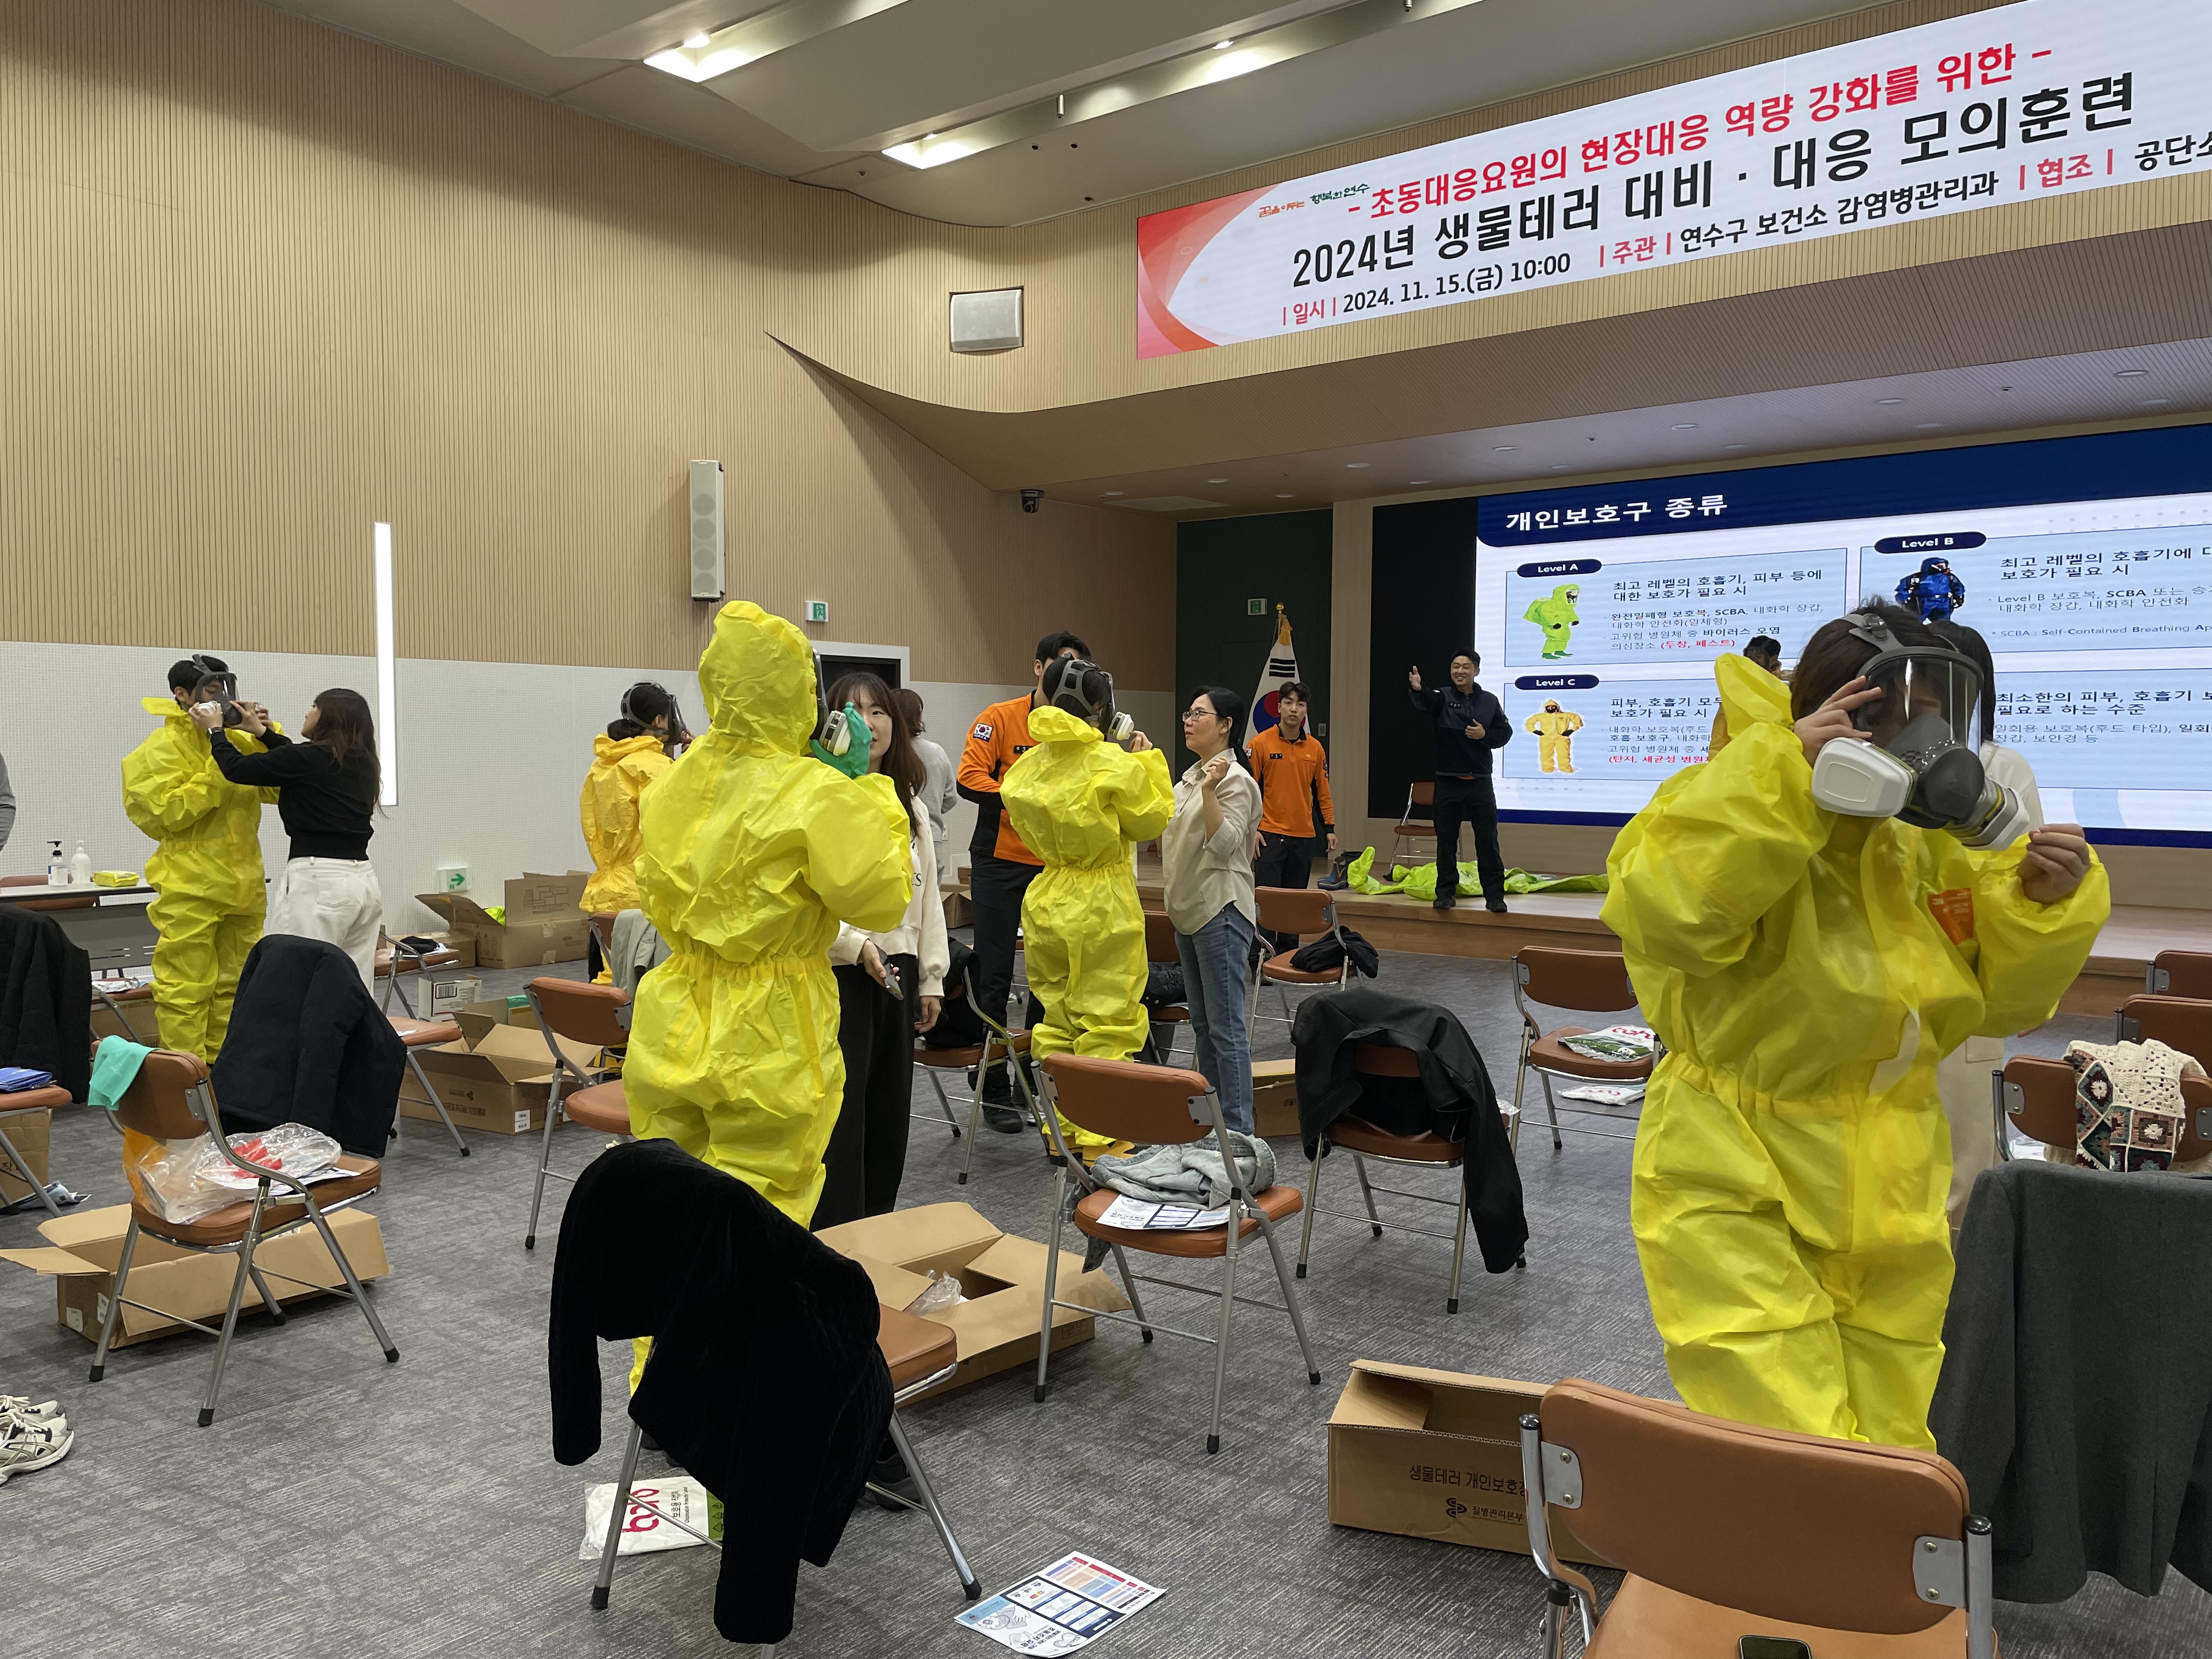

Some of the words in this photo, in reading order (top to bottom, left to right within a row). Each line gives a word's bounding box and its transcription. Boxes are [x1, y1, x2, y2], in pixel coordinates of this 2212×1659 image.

[1369, 145, 1568, 219] 초동대응요원의
[1581, 113, 1710, 172] 현장대응
[1725, 94, 1794, 138] 역량
[1809, 64, 1920, 122] 강화를
[1937, 43, 2017, 92] 위한
[1291, 225, 1415, 287] 2024년
[1434, 184, 1601, 260] 생물테러
[1625, 160, 1712, 221] 대비
[1774, 128, 1872, 190] 대응
[1901, 71, 2134, 166] 모의훈련
[1293, 299, 1327, 325] 일시
[1344, 287, 1394, 313] 2024.
[1400, 280, 1430, 302] 11.
[1436, 263, 1503, 297] 15.(금)
[1511, 253, 1571, 282] 10:00
[1612, 237, 1657, 265] 주관
[1679, 220, 1749, 253] 연수구
[1756, 204, 1829, 238] 보건소
[1838, 171, 2000, 225] 감염병관리과
[2037, 154, 2094, 189] 협조
[1505, 501, 1652, 532] 개인보호구
[1664, 494, 1728, 518] 종류
[1901, 538, 1939, 548] Level
[1944, 537, 1954, 545] B
[2000, 557, 2038, 568] 최고
[2046, 552, 2103, 567] 레벨의
[2112, 547, 2192, 562] 호흡기에
[1538, 564, 1566, 573] Level
[2000, 567, 2057, 580] 보호가
[2066, 566, 2103, 578] 필요
[2112, 564, 2130, 575] 시
[1613, 580, 1642, 591] 최고
[1647, 577, 1691, 589] 레벨의
[1697, 574, 1746, 585] 호흡기,
[1753, 571, 1785, 583] 피부
[1790, 569, 1823, 582] 등에
[1613, 591, 1642, 602] 대한
[1646, 589, 1691, 600] 보호가
[1697, 586, 1727, 597] 필요
[1733, 585, 1747, 596] 시
[1998, 594, 2031, 603] Level
[2051, 591, 2100, 600] 보호복,
[2106, 589, 2147, 598] SCBA
[2152, 587, 2185, 596] 또는
[1999, 602, 2043, 613] 내화학
[2089, 598, 2135, 610] 내화학
[2142, 596, 2190, 608] 안전화
[1611, 611, 1667, 621] 완전밀폐형
[1672, 609, 1711, 618] 보호복,
[1714, 607, 1748, 616] SCBA,
[1754, 605, 1791, 614] 내화학
[1612, 620, 1645, 630] 내화학
[2041, 627, 2128, 636] Self-Contained
[2132, 625, 2190, 633] Breathing
[1610, 631, 1643, 640] 고위험
[1648, 630, 1682, 639] 병원체
[1703, 627, 1751, 637] 바이러스
[1756, 626, 1781, 635] 오염
[1610, 642, 1656, 651] 의심장소
[1536, 679, 1564, 687] Level
[1611, 698, 1642, 708] 피부,
[1647, 697, 1691, 708] 호흡기
[1996, 692, 2071, 703] 최소한의
[2080, 691, 2124, 703] 피부,
[2132, 690, 2192, 702] 호흡기
[1610, 708, 1652, 718] 보호가
[1659, 708, 1688, 719] 필요
[1694, 708, 1707, 718] 시
[1997, 704, 2052, 715] 필요로
[2061, 704, 2098, 715] 하는
[2107, 703, 2146, 715] 수준
[1995, 724, 2038, 733] 일회용
[2179, 724, 2212, 733] 일회
[1635, 734, 1672, 742] 보호구,
[2033, 734, 2076, 743] 보안경
[2084, 734, 2099, 743] 등
[1607, 745, 1640, 753] 고위험
[1642, 755, 1676, 764] 세균성
[1409, 1464, 1461, 1487] 생물테러
[1472, 1505, 1524, 1522] 질병관리본부
